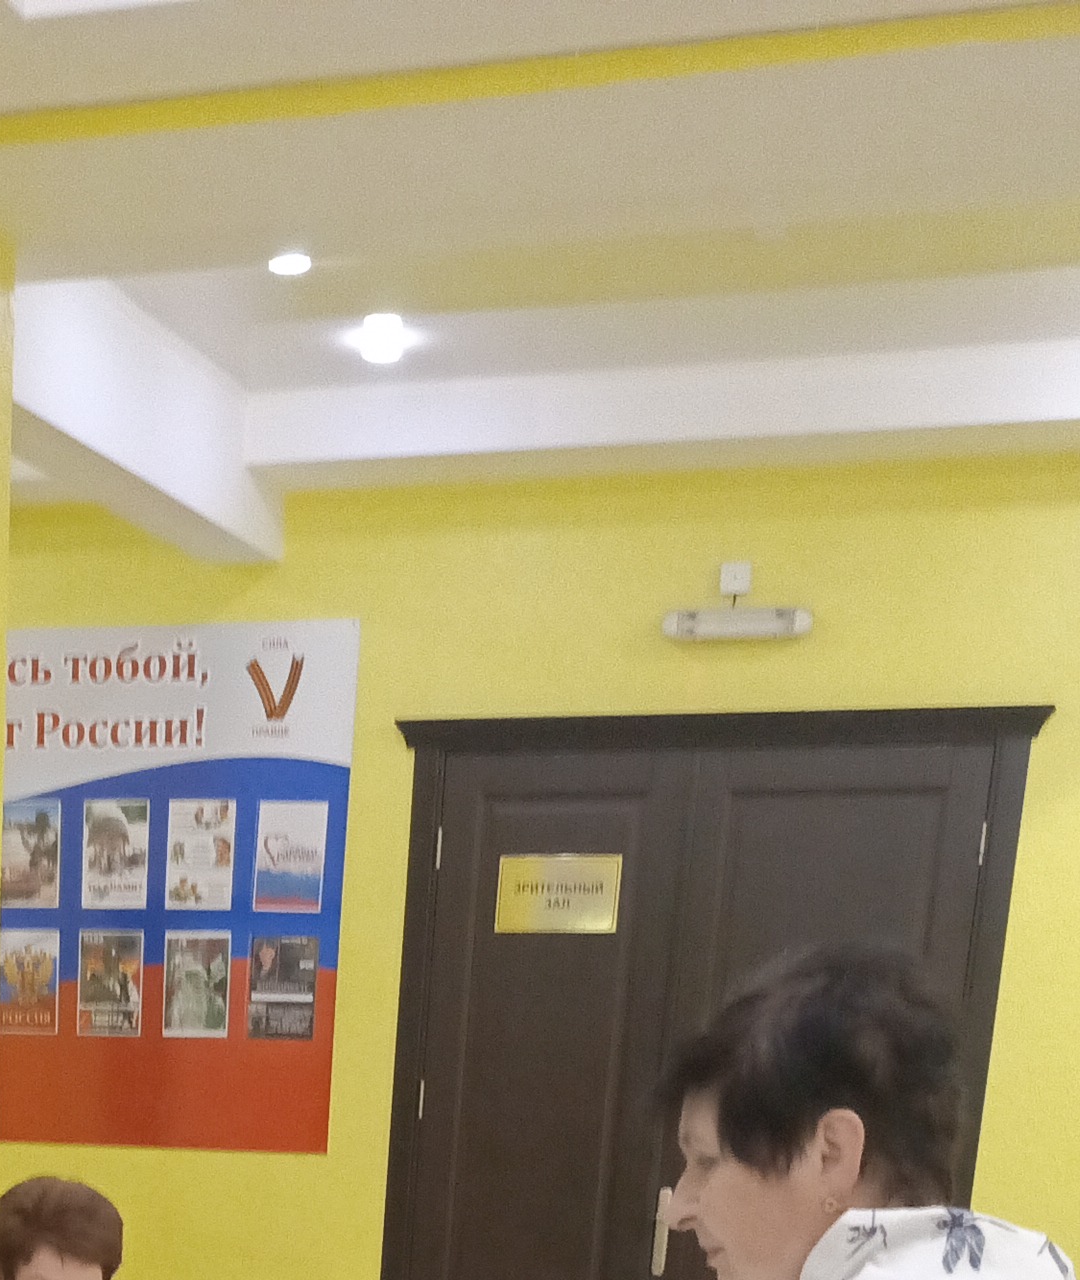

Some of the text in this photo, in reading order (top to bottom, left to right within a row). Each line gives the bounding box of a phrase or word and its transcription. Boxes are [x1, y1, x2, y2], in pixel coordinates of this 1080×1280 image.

[7, 640, 208, 687] сь тобой,
[35, 707, 205, 749] России!
[514, 881, 604, 896] ЗРИТЕЛЬНЫЙ
[547, 897, 571, 910] ЗАЛ
